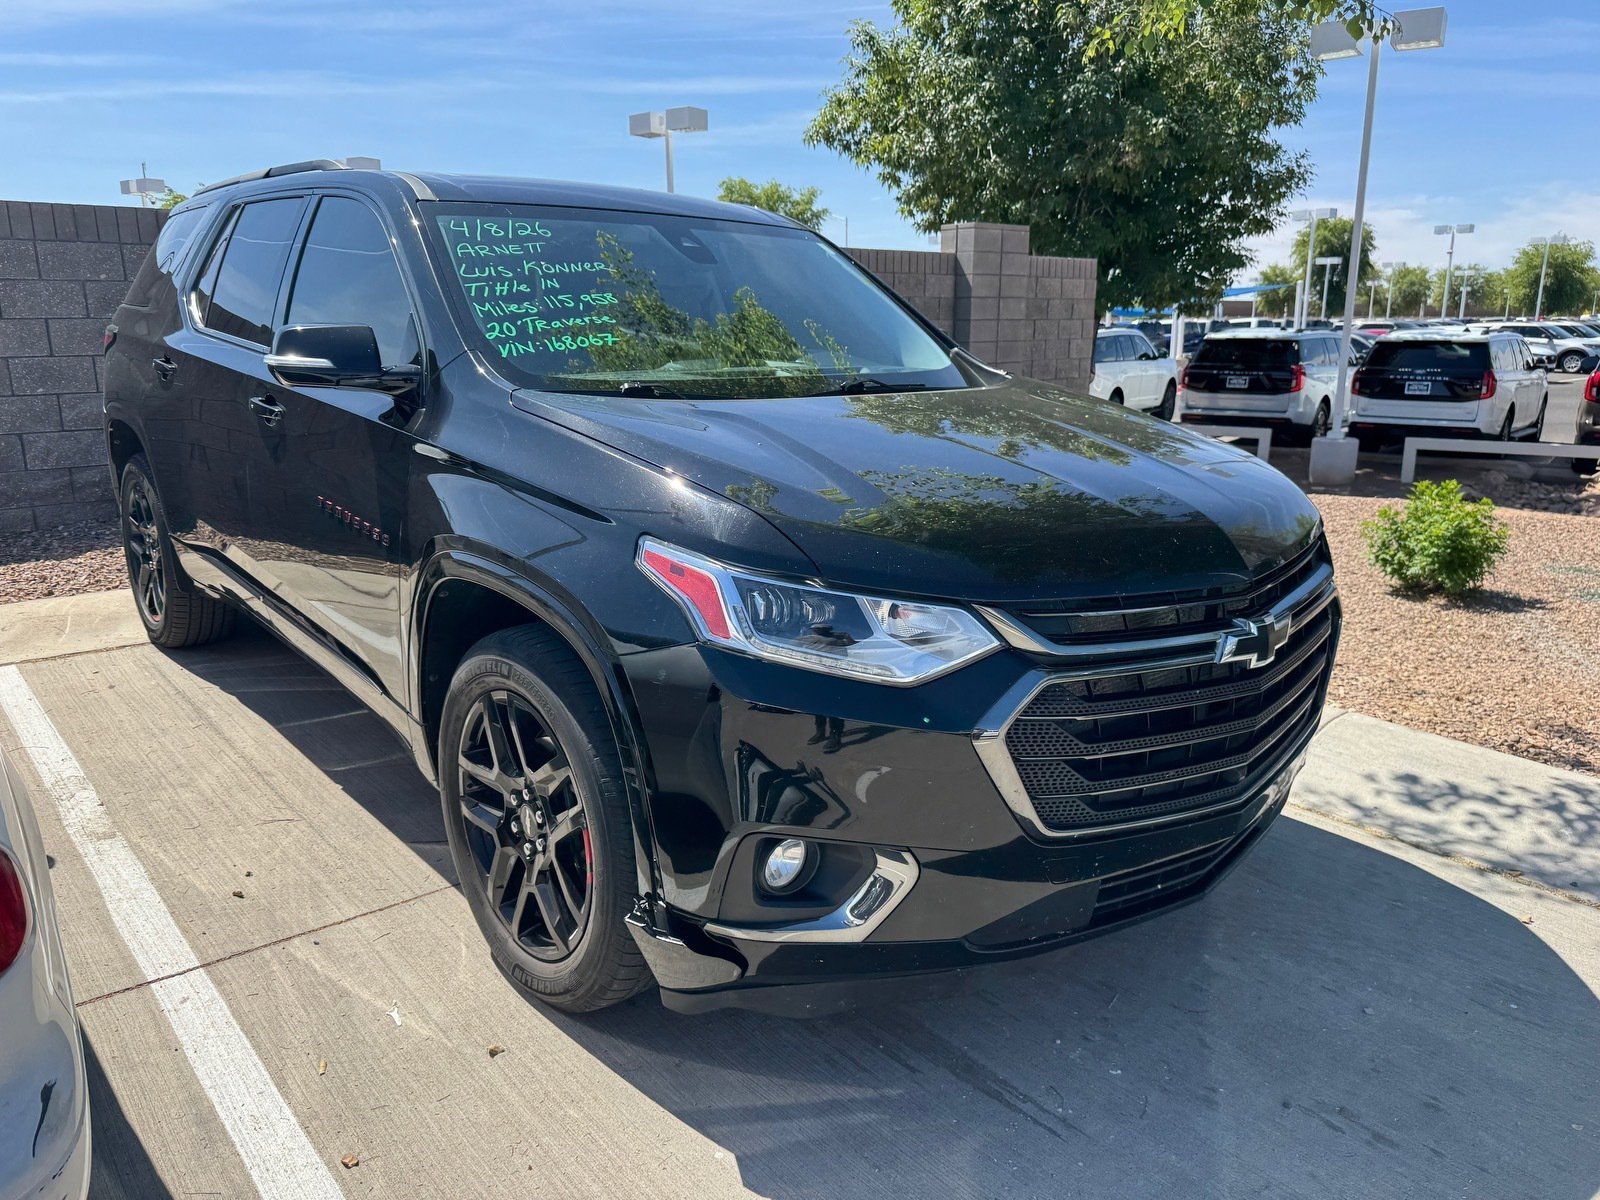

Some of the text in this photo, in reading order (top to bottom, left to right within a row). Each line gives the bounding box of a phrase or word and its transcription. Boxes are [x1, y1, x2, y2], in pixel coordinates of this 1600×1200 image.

[450, 219, 551, 241] 4/8/26
[456, 242, 547, 257] ARNETT
[541, 278, 560, 290] IN
[544, 292, 618, 311] 115,958
